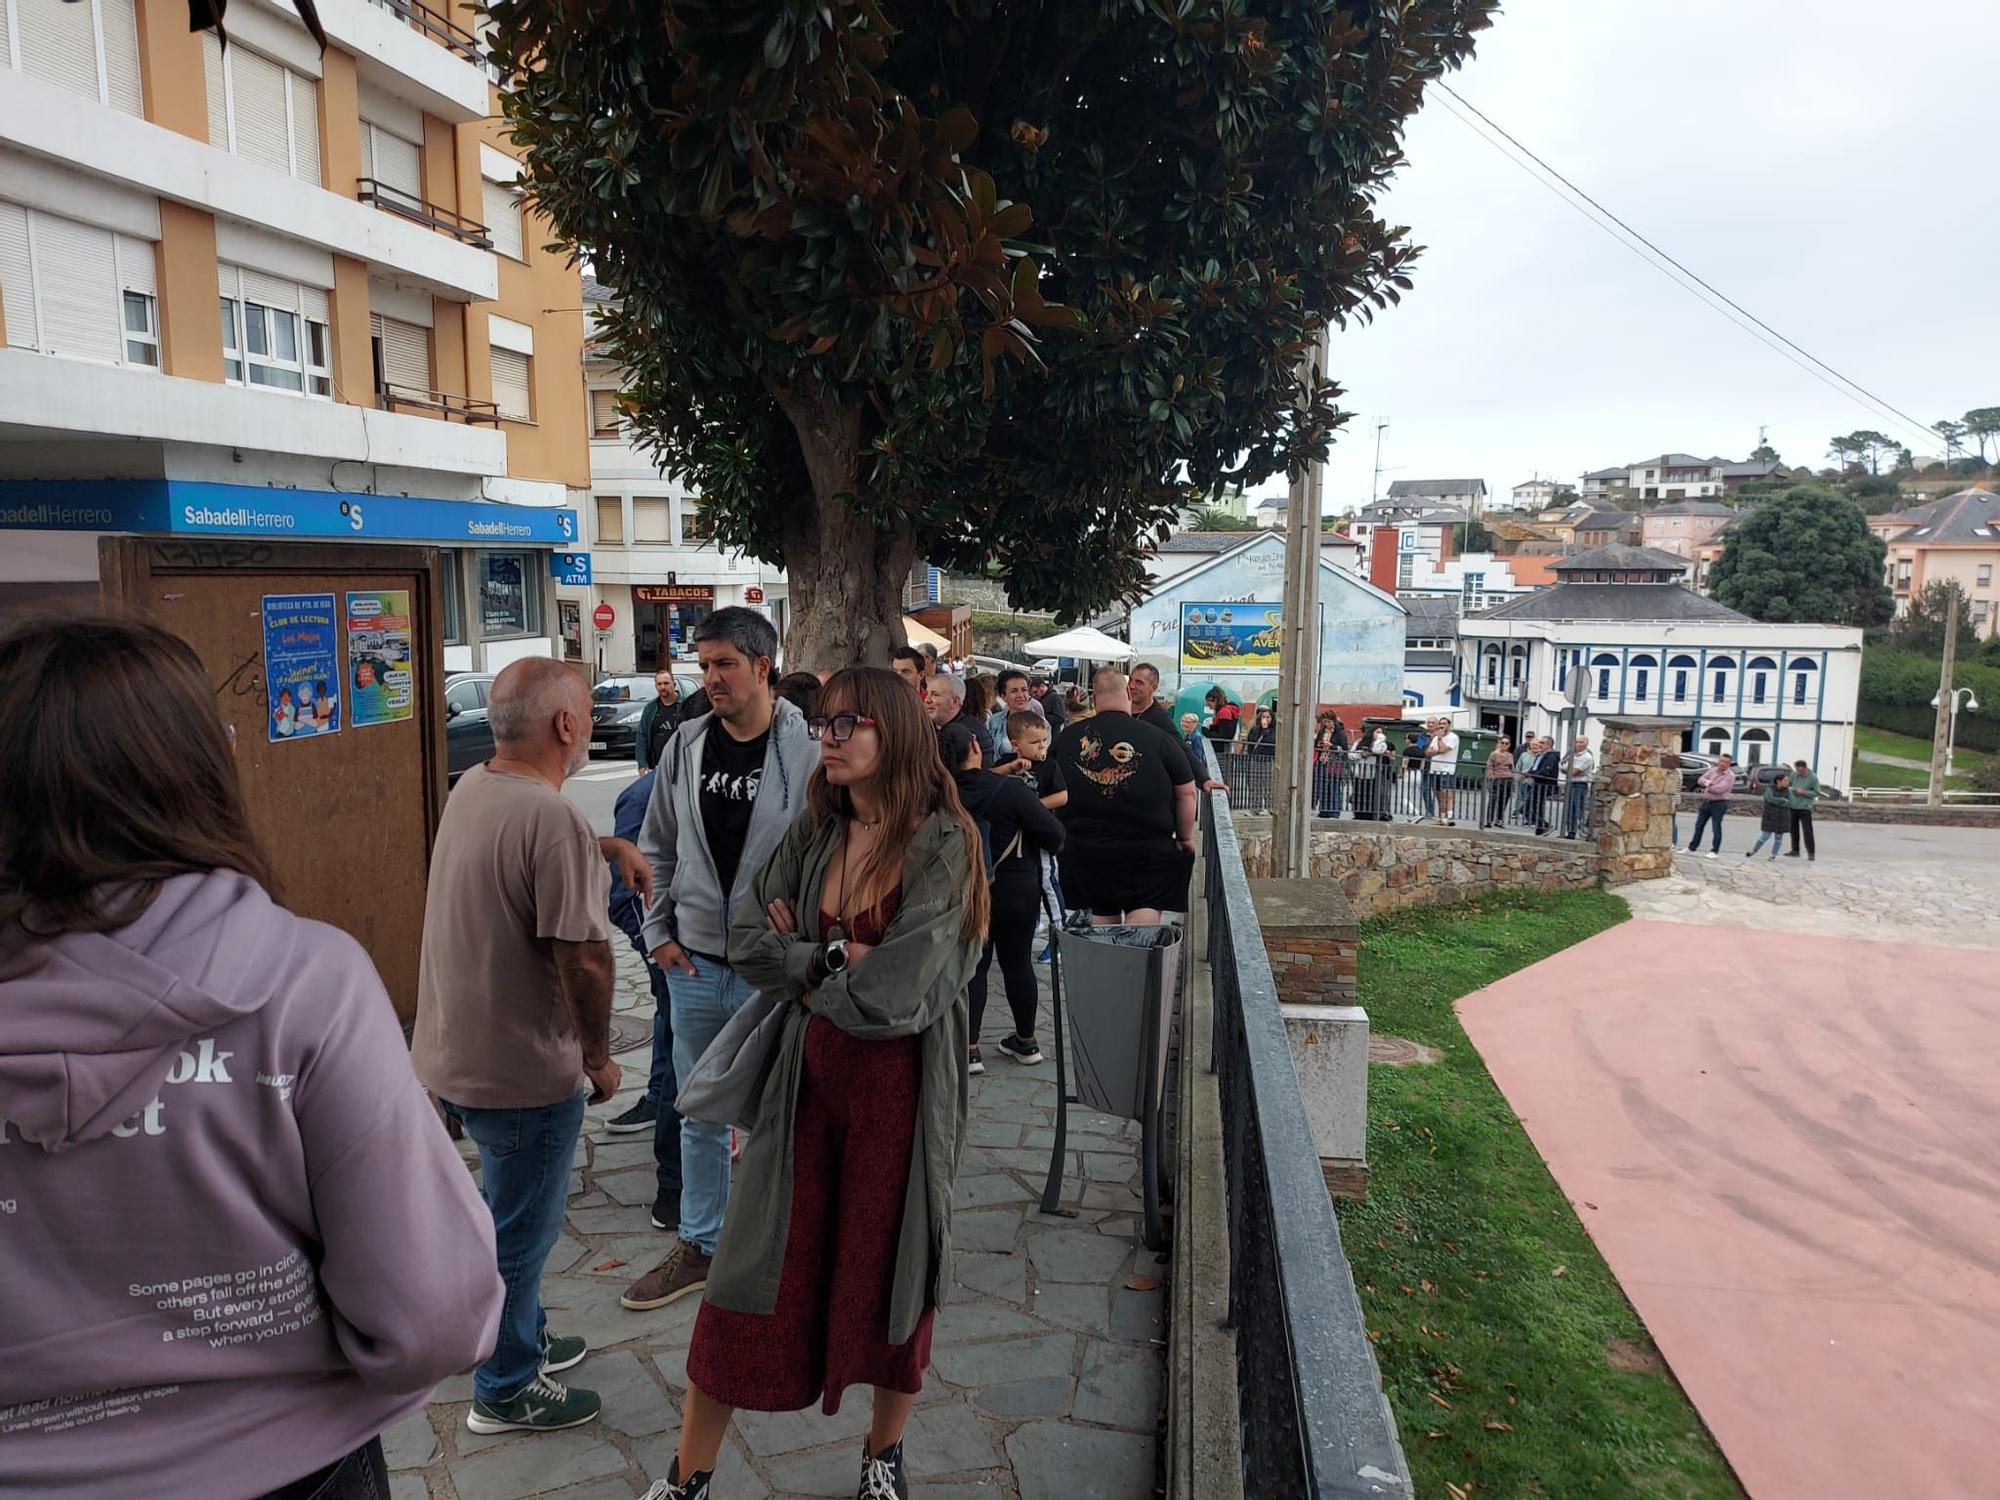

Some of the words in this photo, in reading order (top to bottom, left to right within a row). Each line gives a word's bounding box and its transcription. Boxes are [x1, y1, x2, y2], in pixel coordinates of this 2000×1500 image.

[185, 505, 295, 529] SabadellHerrero
[467, 520, 532, 537] SabadellHerrero
[565, 574, 587, 584] ATM
[653, 587, 710, 597] TABACOS
[266, 602, 294, 611] BIBLIOTECA
[269, 617, 288, 629] CLUB
[290, 616, 298, 625] DE
[300, 614, 330, 625] LECTURA
[128, 1280, 180, 1298] Some
[182, 1273, 233, 1293] pages
[235, 1269, 257, 1285] go
[259, 1265, 273, 1278] in
[157, 1292, 208, 1310] others
[211, 1285, 233, 1300] fall
[235, 1282, 257, 1297] off
[259, 1277, 283, 1293] the
[193, 1306, 222, 1322] But
[224, 1298, 266, 1317] every
[162, 1329, 174, 1342] a
[176, 1325, 212, 1340] step
[214, 1309, 275, 1333] forward
[208, 1332, 253, 1349] when
[255, 1319, 300, 1343] you're
[2, 1420, 31, 1433] Lines
[32, 1412, 65, 1427] drawn
[66, 1402, 104, 1419] without
[143, 1385, 180, 1400] shapes
[17, 1399, 51, 1416] lead
[44, 1420, 76, 1433] made
[77, 1415, 94, 1426] out
[95, 1411, 105, 1421] of
